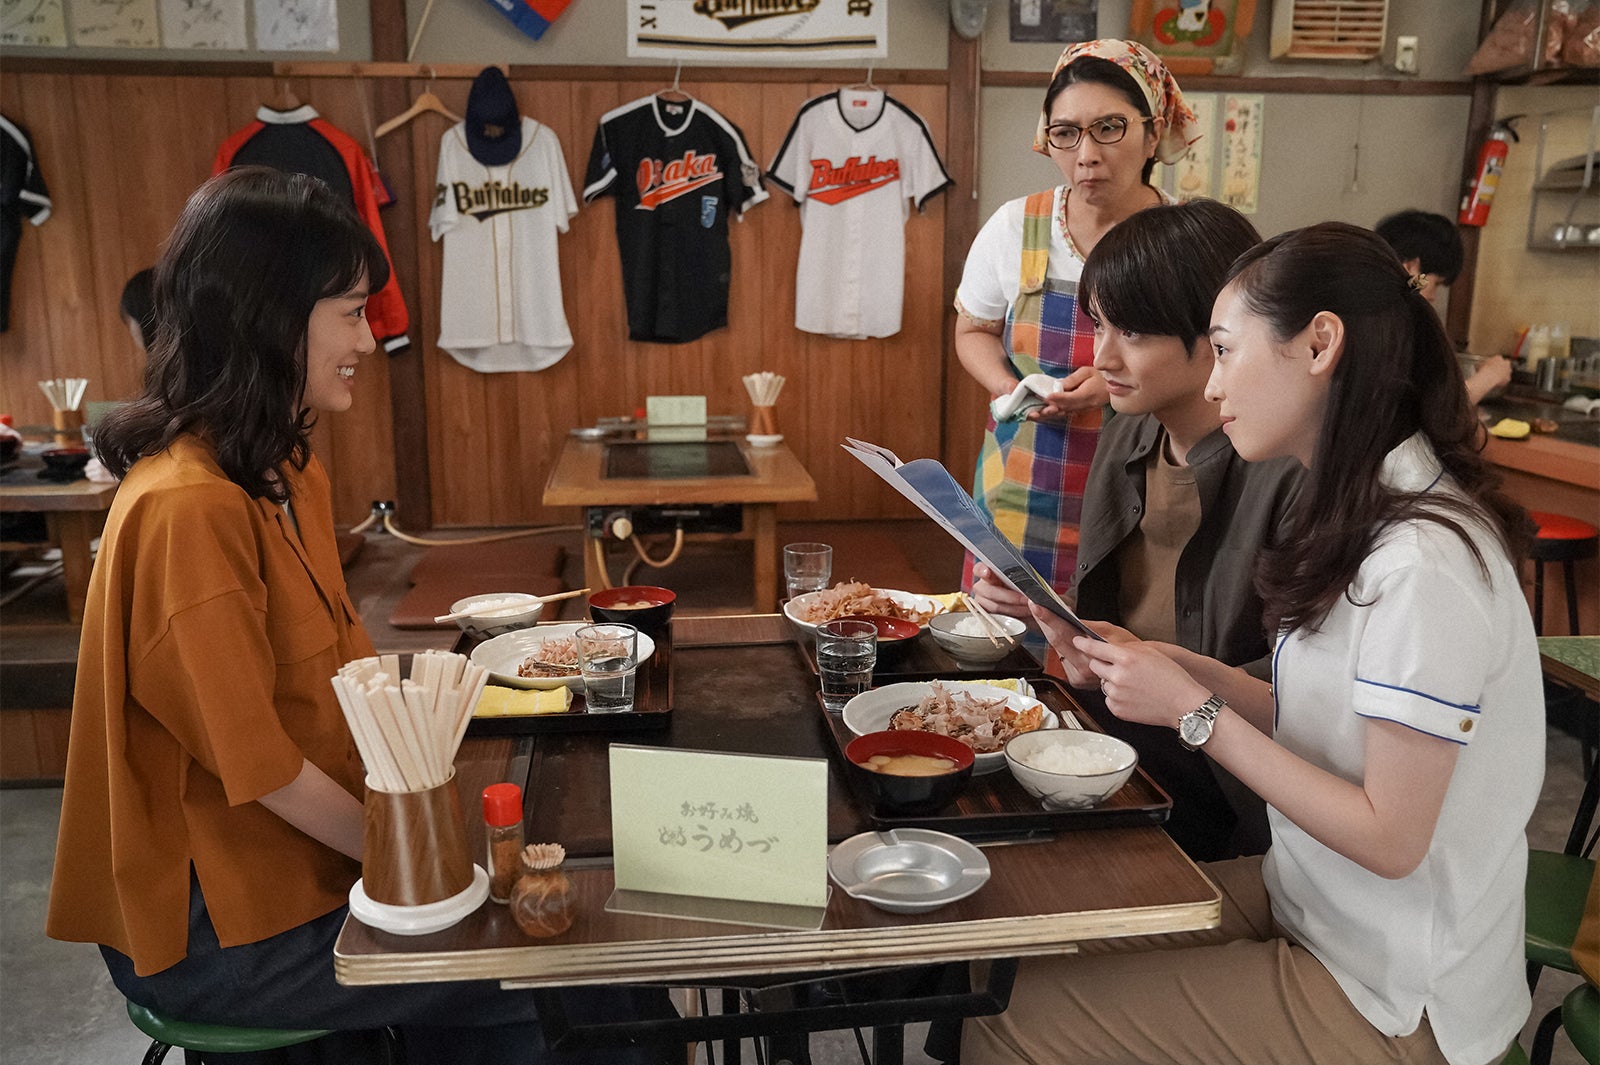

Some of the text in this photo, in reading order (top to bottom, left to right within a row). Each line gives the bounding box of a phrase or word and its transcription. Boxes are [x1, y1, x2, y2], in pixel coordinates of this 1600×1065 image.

[636, 150, 718, 196] Osaka
[810, 156, 900, 190] Buffaloes
[452, 181, 549, 215] Buffaloes
[701, 196, 718, 229] 5
[680, 801, 759, 824] お好み焼
